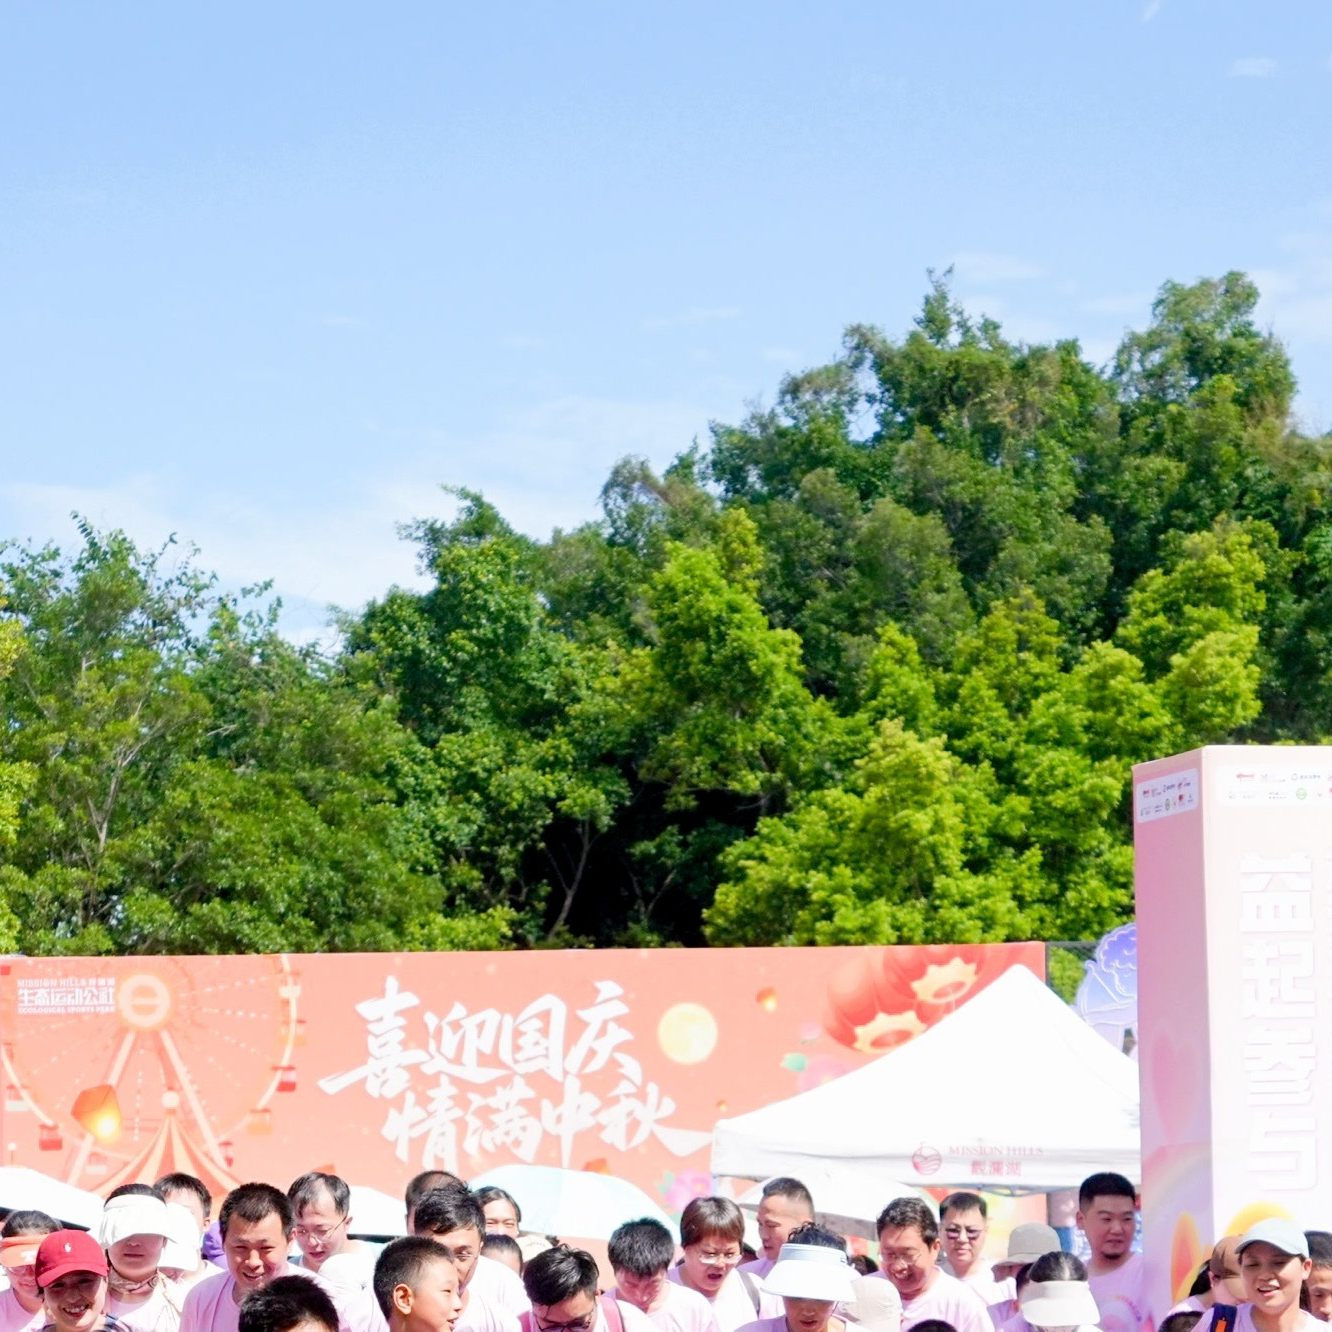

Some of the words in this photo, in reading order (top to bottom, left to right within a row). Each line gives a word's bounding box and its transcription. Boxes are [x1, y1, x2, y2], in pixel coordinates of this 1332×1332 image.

[18, 979, 57, 987] MISSION
[18, 988, 115, 1006] 生态运动公社
[317, 975, 642, 1098] 喜迎国庆
[1239, 852, 1316, 1190] 益起参与
[381, 1073, 715, 1173] 情满中秋
[949, 1146, 1003, 1156] MISSION
[1007, 1146, 1044, 1156] HILLS
